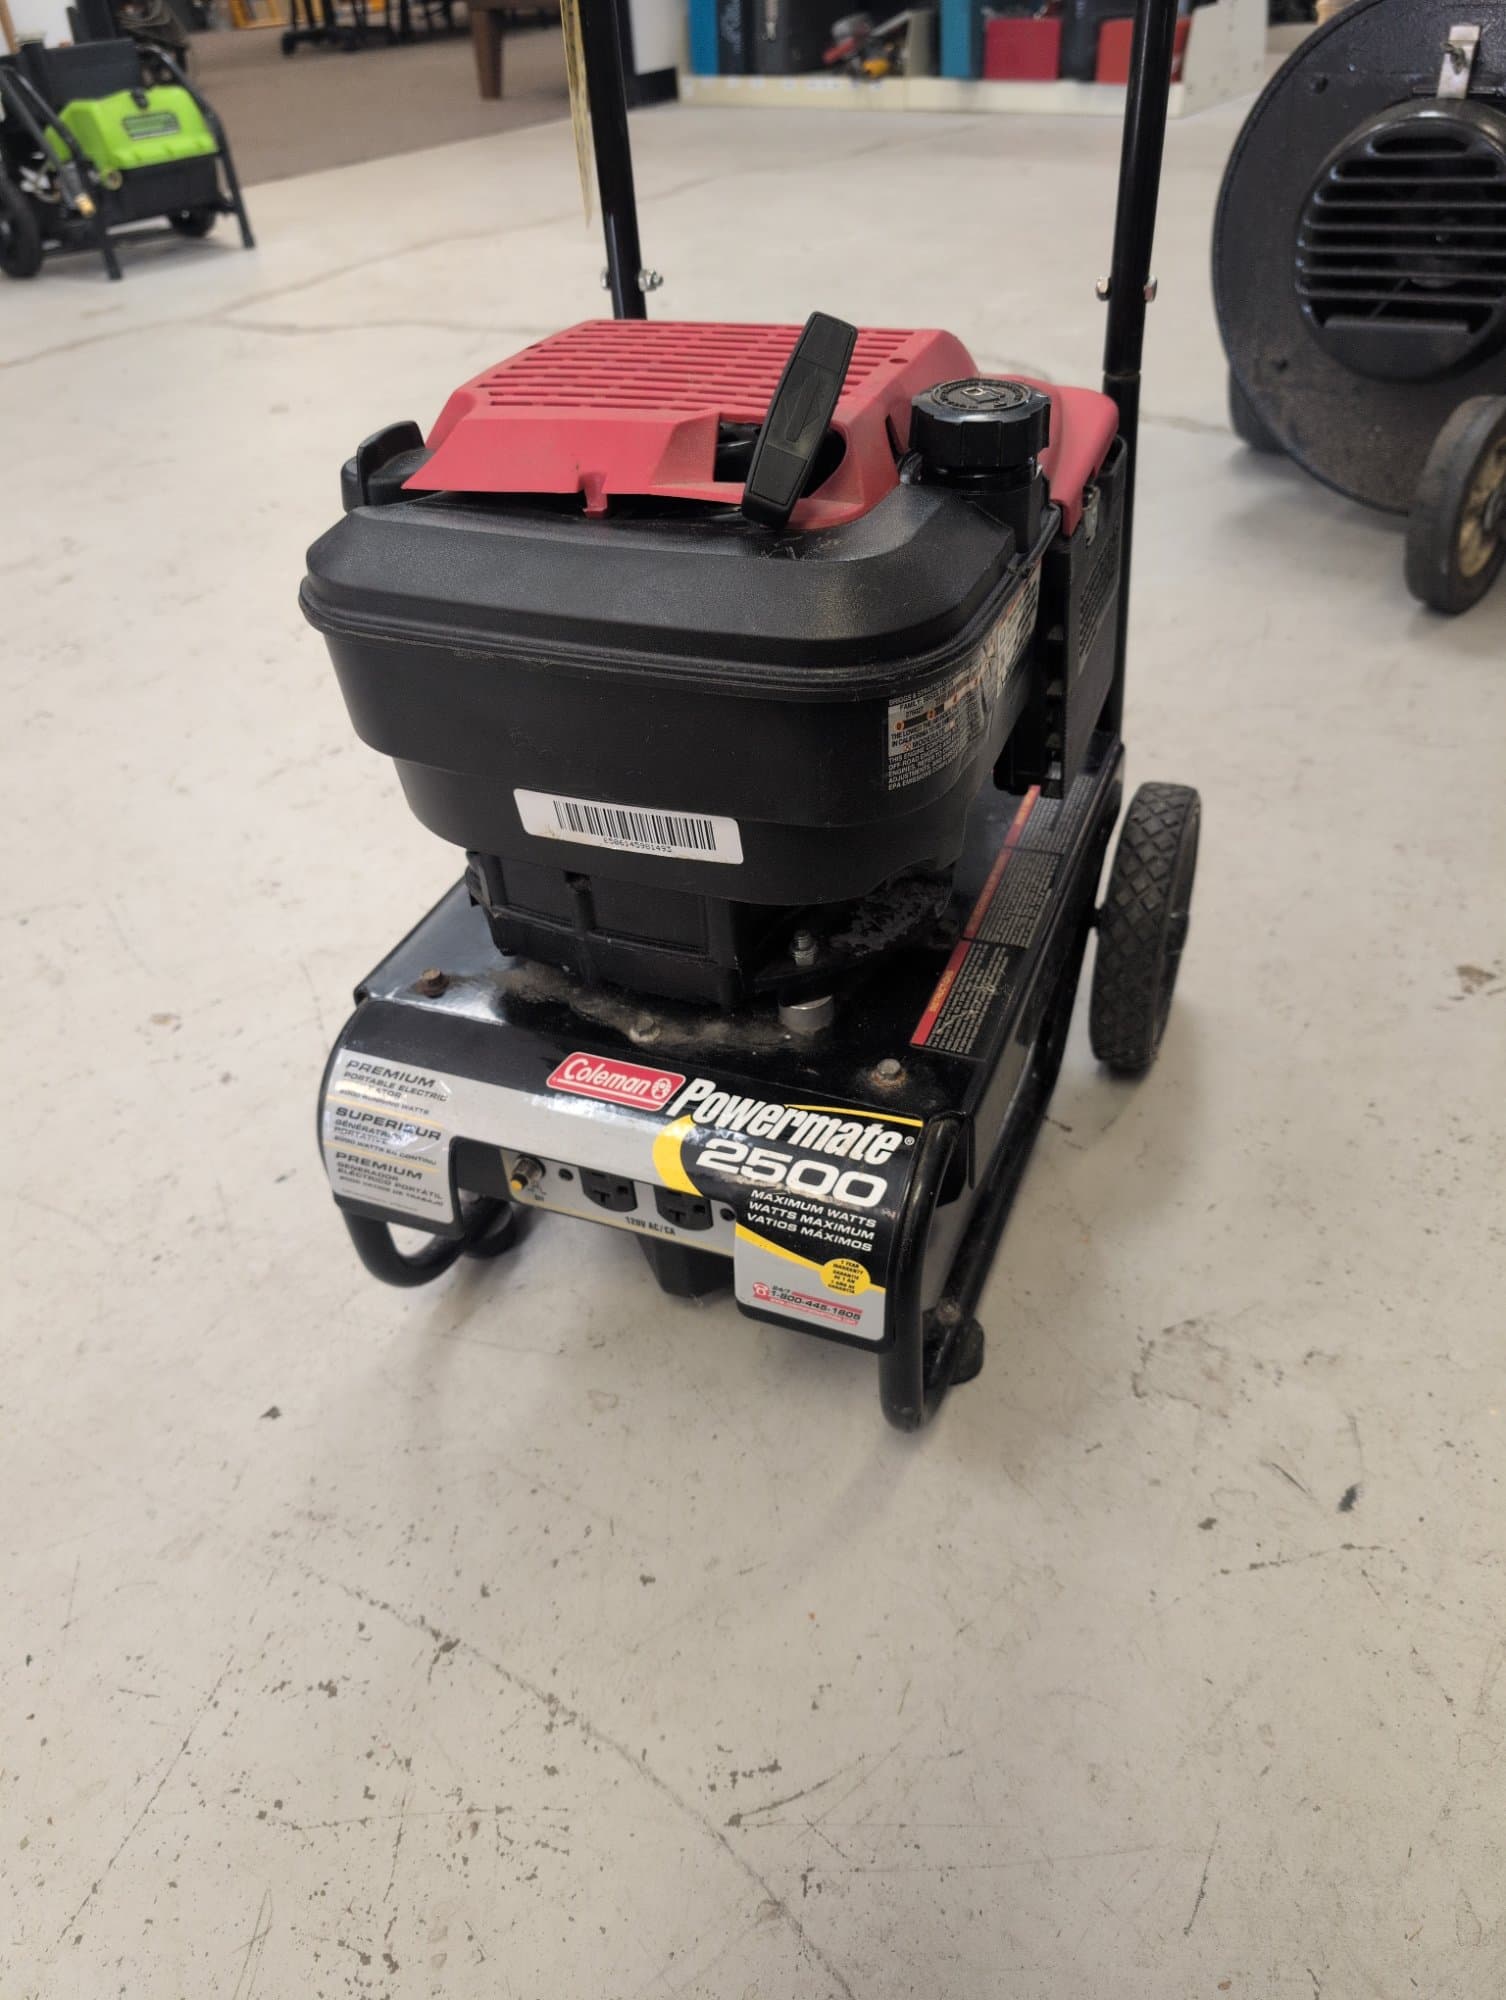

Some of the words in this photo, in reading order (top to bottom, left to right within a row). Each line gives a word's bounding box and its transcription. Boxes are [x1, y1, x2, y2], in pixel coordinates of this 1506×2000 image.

[343, 1071, 396, 1088] PORTABLE
[398, 1085, 448, 1102] ELECTRIC
[346, 1060, 436, 1088] PREMIUM
[563, 1058, 652, 1097] Coleman
[402, 1104, 430, 1115] WATTS
[666, 1078, 903, 1166] Powermate
[335, 1151, 423, 1180] PREMIUM
[337, 1162, 399, 1181] GENERADOR
[696, 1138, 888, 1208] 2500
[749, 1201, 797, 1220] WATTS
[800, 1214, 875, 1240] MAXIMUM
[751, 1190, 824, 1214] MAXIMUM
[827, 1209, 877, 1228] WATTS
[625, 1216, 646, 1229] 120V
[648, 1222, 676, 1236] AC/CA
[747, 1213, 797, 1232] VATIOS
[800, 1226, 873, 1252] MÁXIMOS
[771, 1291, 861, 1320] 1-800-445-1805
